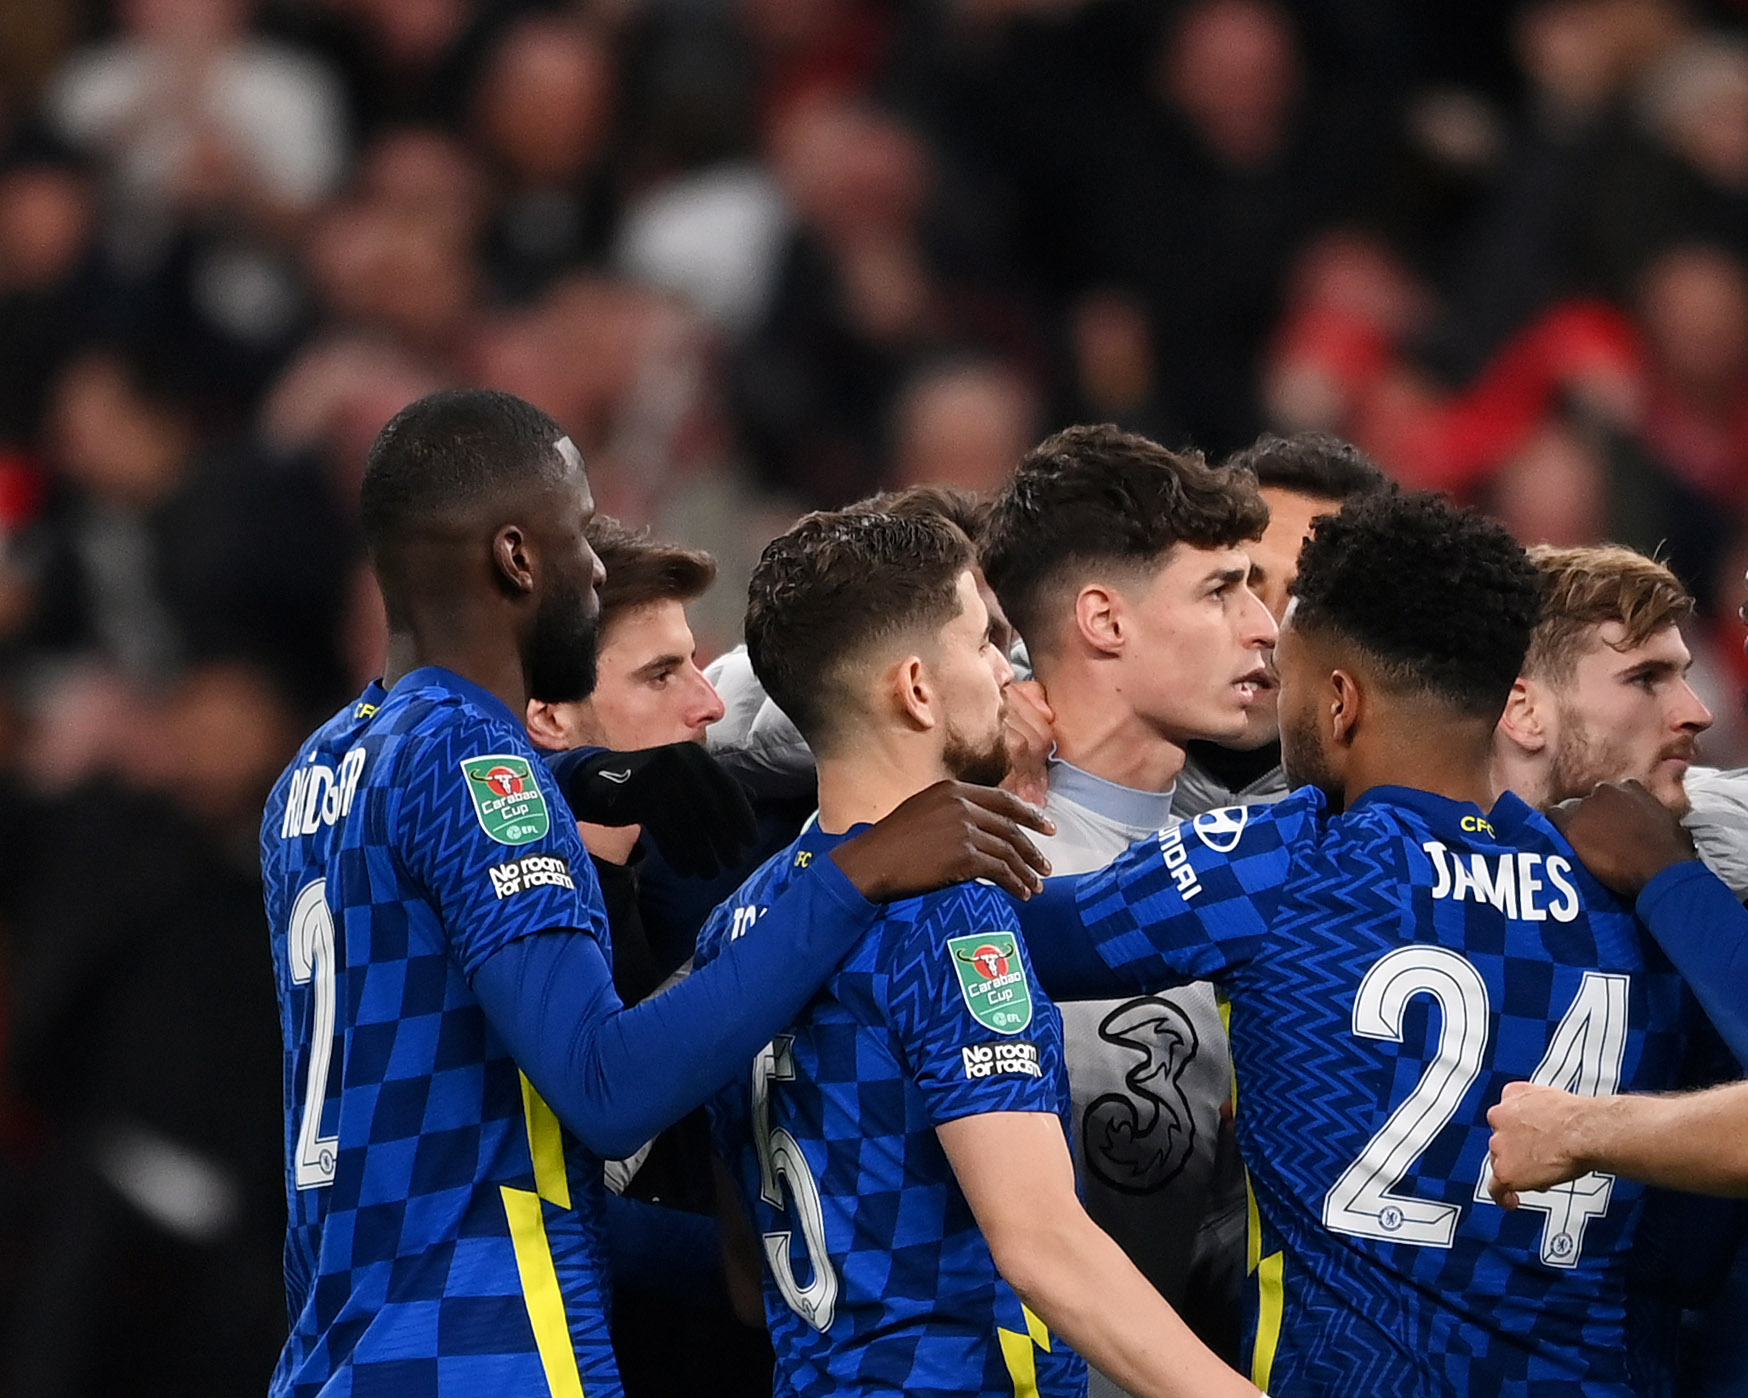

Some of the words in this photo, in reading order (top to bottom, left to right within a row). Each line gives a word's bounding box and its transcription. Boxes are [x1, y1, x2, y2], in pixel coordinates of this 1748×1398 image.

[481, 790, 538, 815] Carabao
[501, 803, 529, 820] Cup
[489, 864, 519, 885] No
[520, 857, 566, 874] room
[1423, 841, 1579, 922] JAMES
[495, 877, 520, 900] for
[968, 971, 1022, 997] Carabao
[988, 988, 1013, 1005] Cup
[288, 876, 339, 1191] 2
[962, 1045, 992, 1063] No
[995, 1044, 1037, 1061] room
[965, 1061, 994, 1079] for
[1322, 944, 1631, 1268] 24
[752, 1034, 838, 1333] 5
